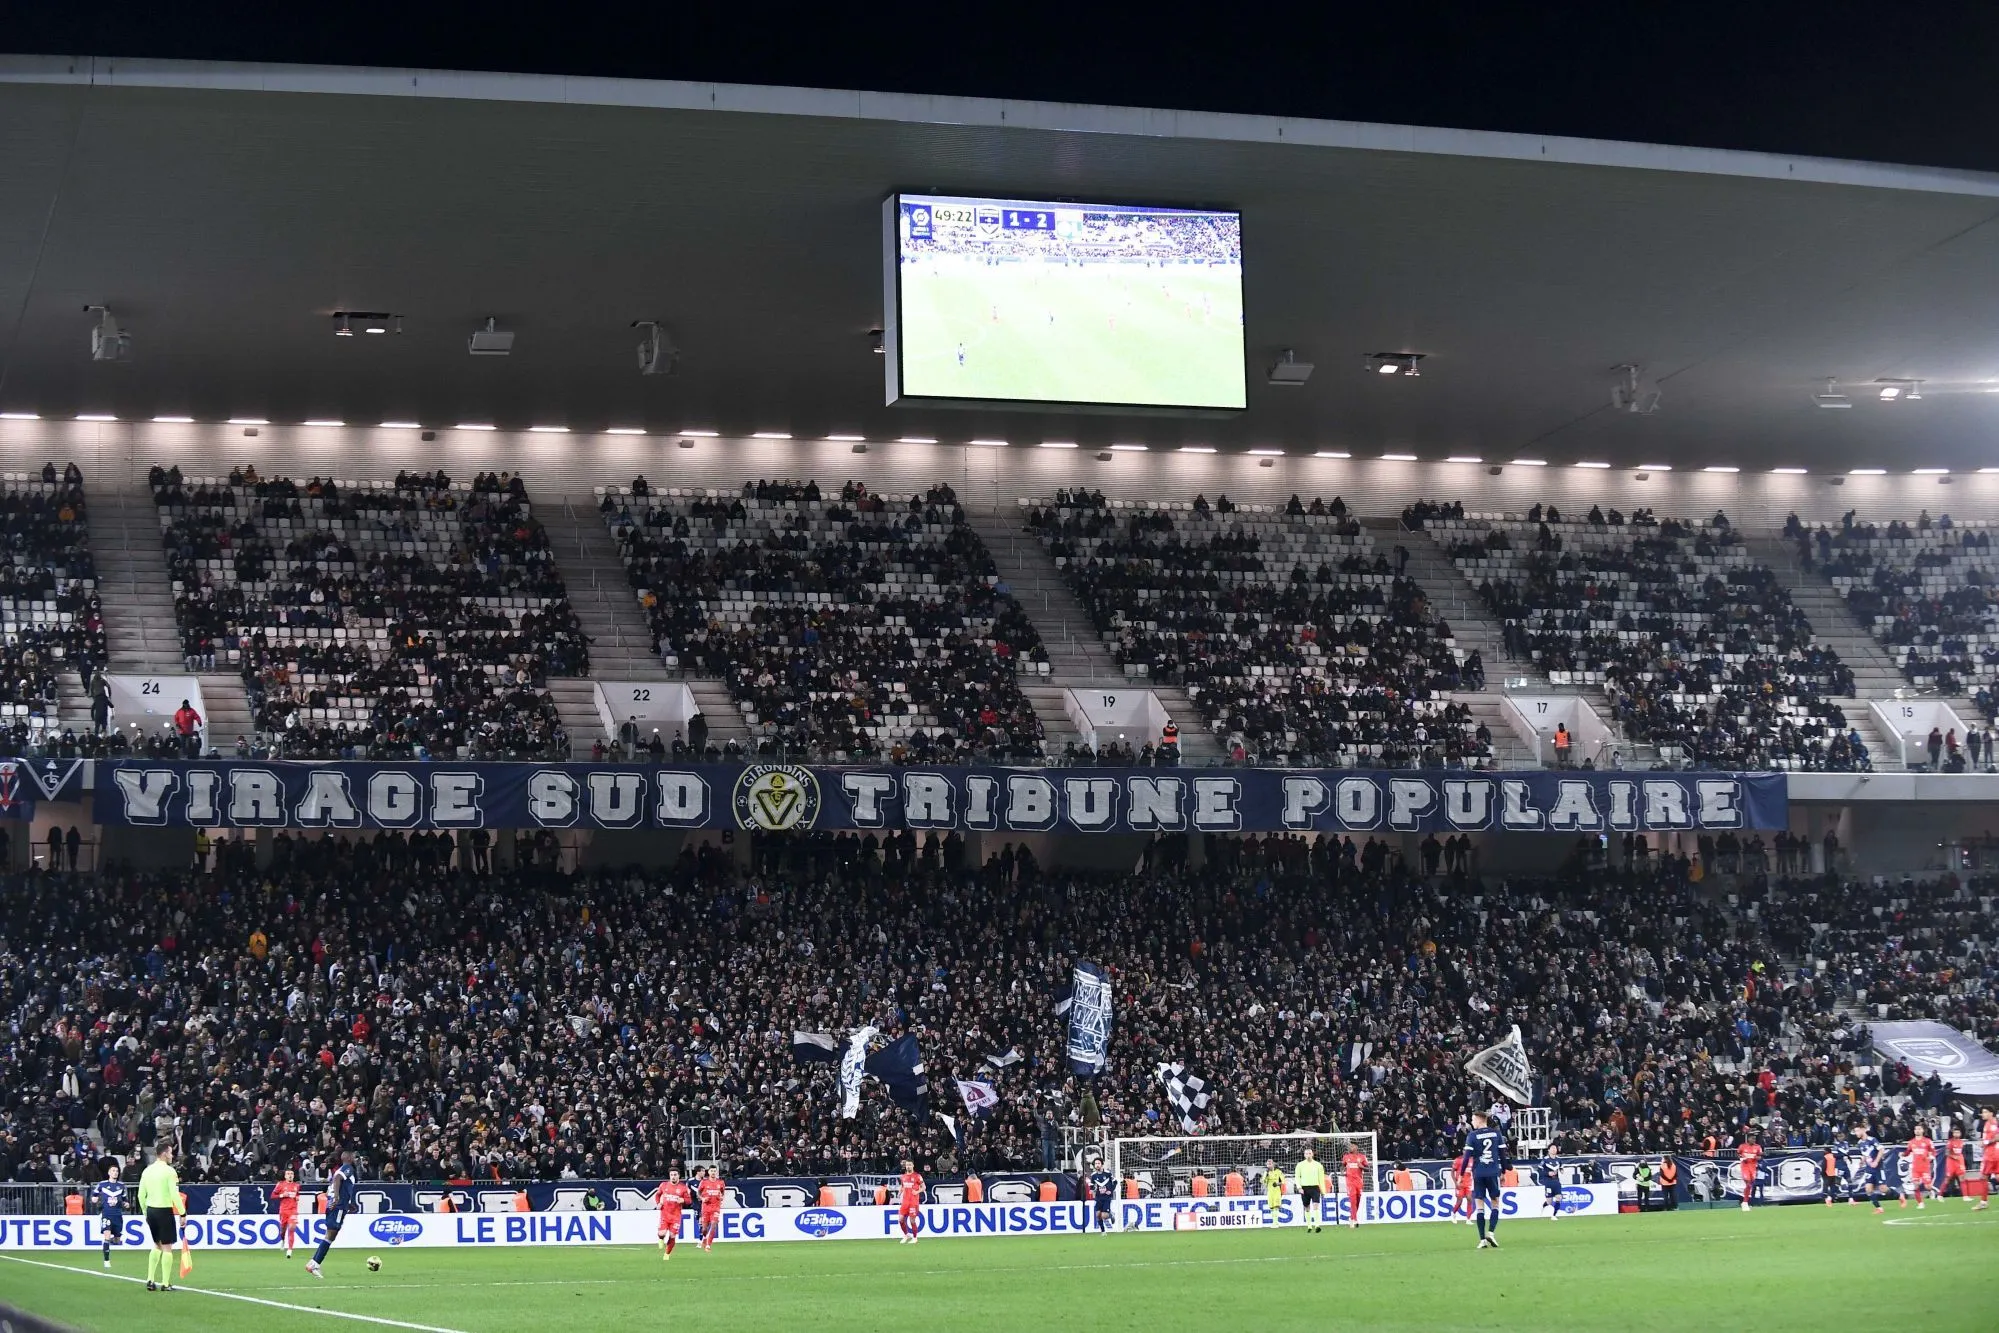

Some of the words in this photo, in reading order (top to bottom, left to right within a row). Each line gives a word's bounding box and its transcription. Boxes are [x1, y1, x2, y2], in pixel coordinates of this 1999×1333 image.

[935, 209, 972, 222] 49:22
[1009, 212, 1020, 226] 1
[1037, 213, 1048, 228] 2
[142, 682, 160, 694] 24
[633, 689, 650, 701] 22
[1102, 695, 1115, 707] 19
[1537, 702, 1548, 713] 17
[1902, 706, 1913, 717] 15
[743, 764, 811, 788] GIRONDINS
[114, 769, 484, 828] VIRAGE
[527, 770, 711, 829] SUD
[842, 771, 1242, 832] TRIBUNE
[1281, 776, 1743, 831] POPULAIRE
[1482, 1138, 1493, 1154] 2
[1122, 1202, 1162, 1228] DE
[1200, 1215, 1217, 1227] SUD
[84, 1219, 145, 1246] LS
[457, 1217, 494, 1243] LE
[506, 1216, 612, 1242] BIHAN
